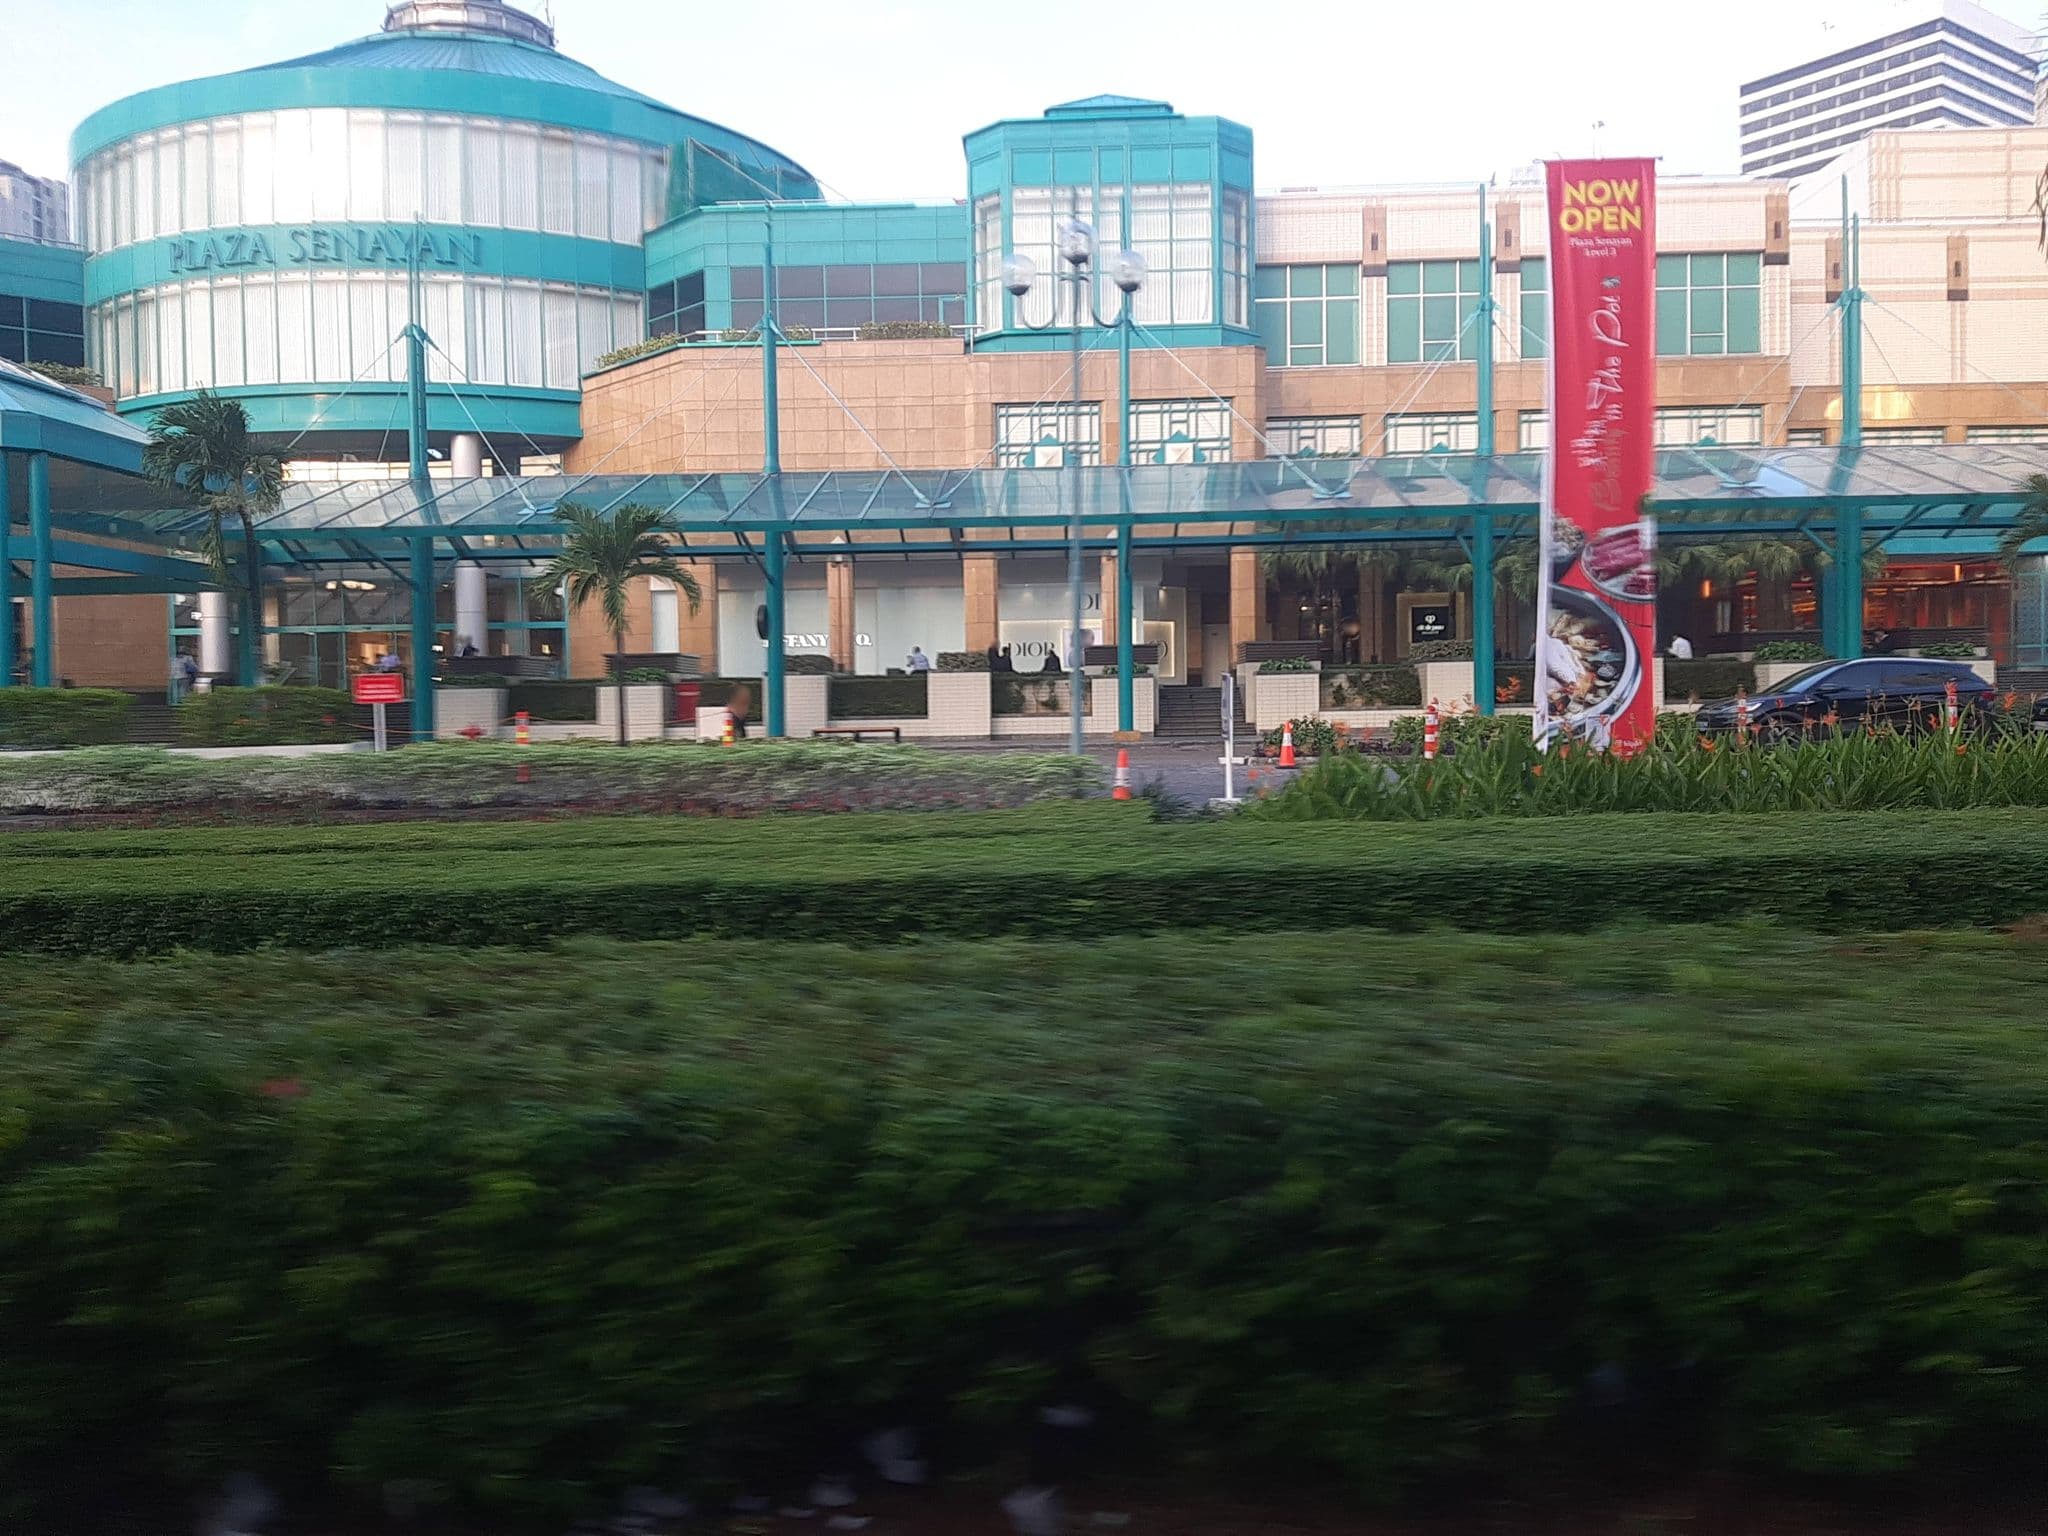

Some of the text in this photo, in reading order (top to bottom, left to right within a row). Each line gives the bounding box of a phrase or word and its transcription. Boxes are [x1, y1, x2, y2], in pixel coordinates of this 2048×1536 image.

[1564, 179, 1639, 206] NOW
[1560, 205, 1642, 233] OPEN
[168, 227, 481, 274] PLAZA SENAYAN
